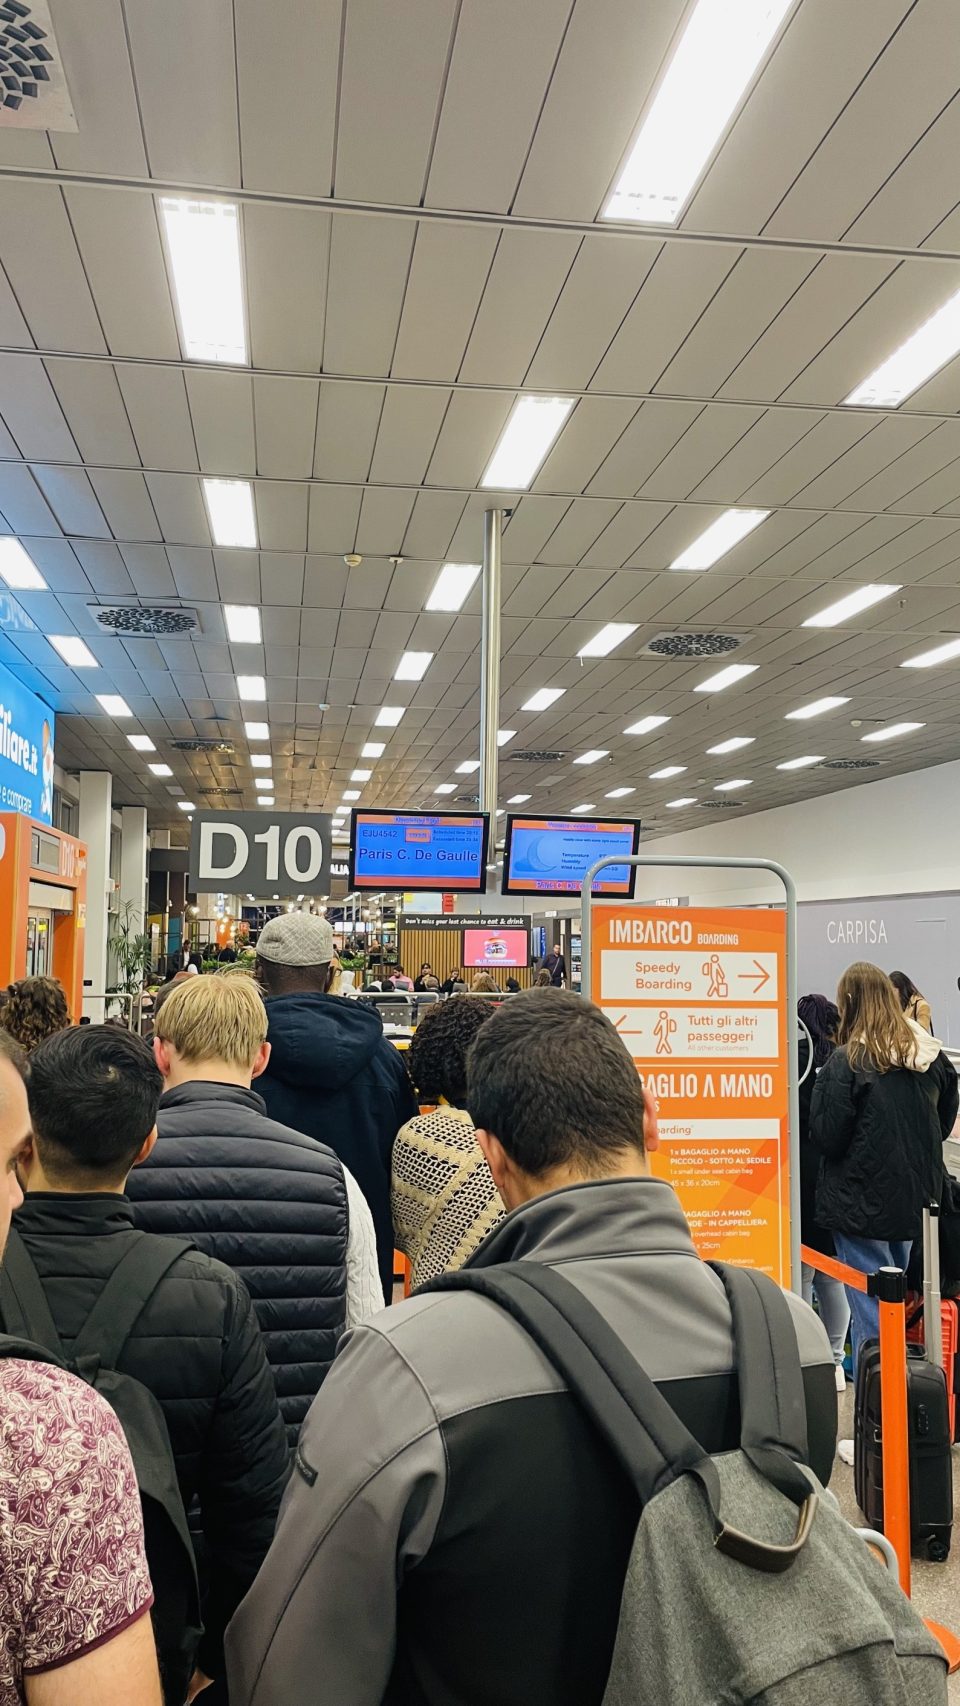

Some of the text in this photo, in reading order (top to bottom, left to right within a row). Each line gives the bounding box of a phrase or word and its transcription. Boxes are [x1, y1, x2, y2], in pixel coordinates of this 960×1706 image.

[7, 787, 33, 814] comprare
[362, 829, 398, 838] EJU4542
[199, 822, 323, 883] D10
[359, 848, 478, 861] Paris C. De Gaulle
[405, 917, 421, 925] Don't
[435, 918, 448, 926] your
[499, 917, 506, 925] &
[507, 917, 524, 925] drink
[609, 919, 739, 945] IMBARCO BOARDING
[827, 919, 888, 944] CARPISA
[635, 961, 681, 975] Speedy
[635, 978, 692, 991] Boarding
[687, 1014, 758, 1028] Tutti gli altri
[687, 1031, 754, 1043] passeggeri
[702, 1073, 716, 1098] A
[720, 1073, 773, 1098] MANO
[741, 1168, 753, 1176] bag
[700, 1179, 720, 1187] 20cm
[718, 1219, 768, 1227] CAPPELLIERA
